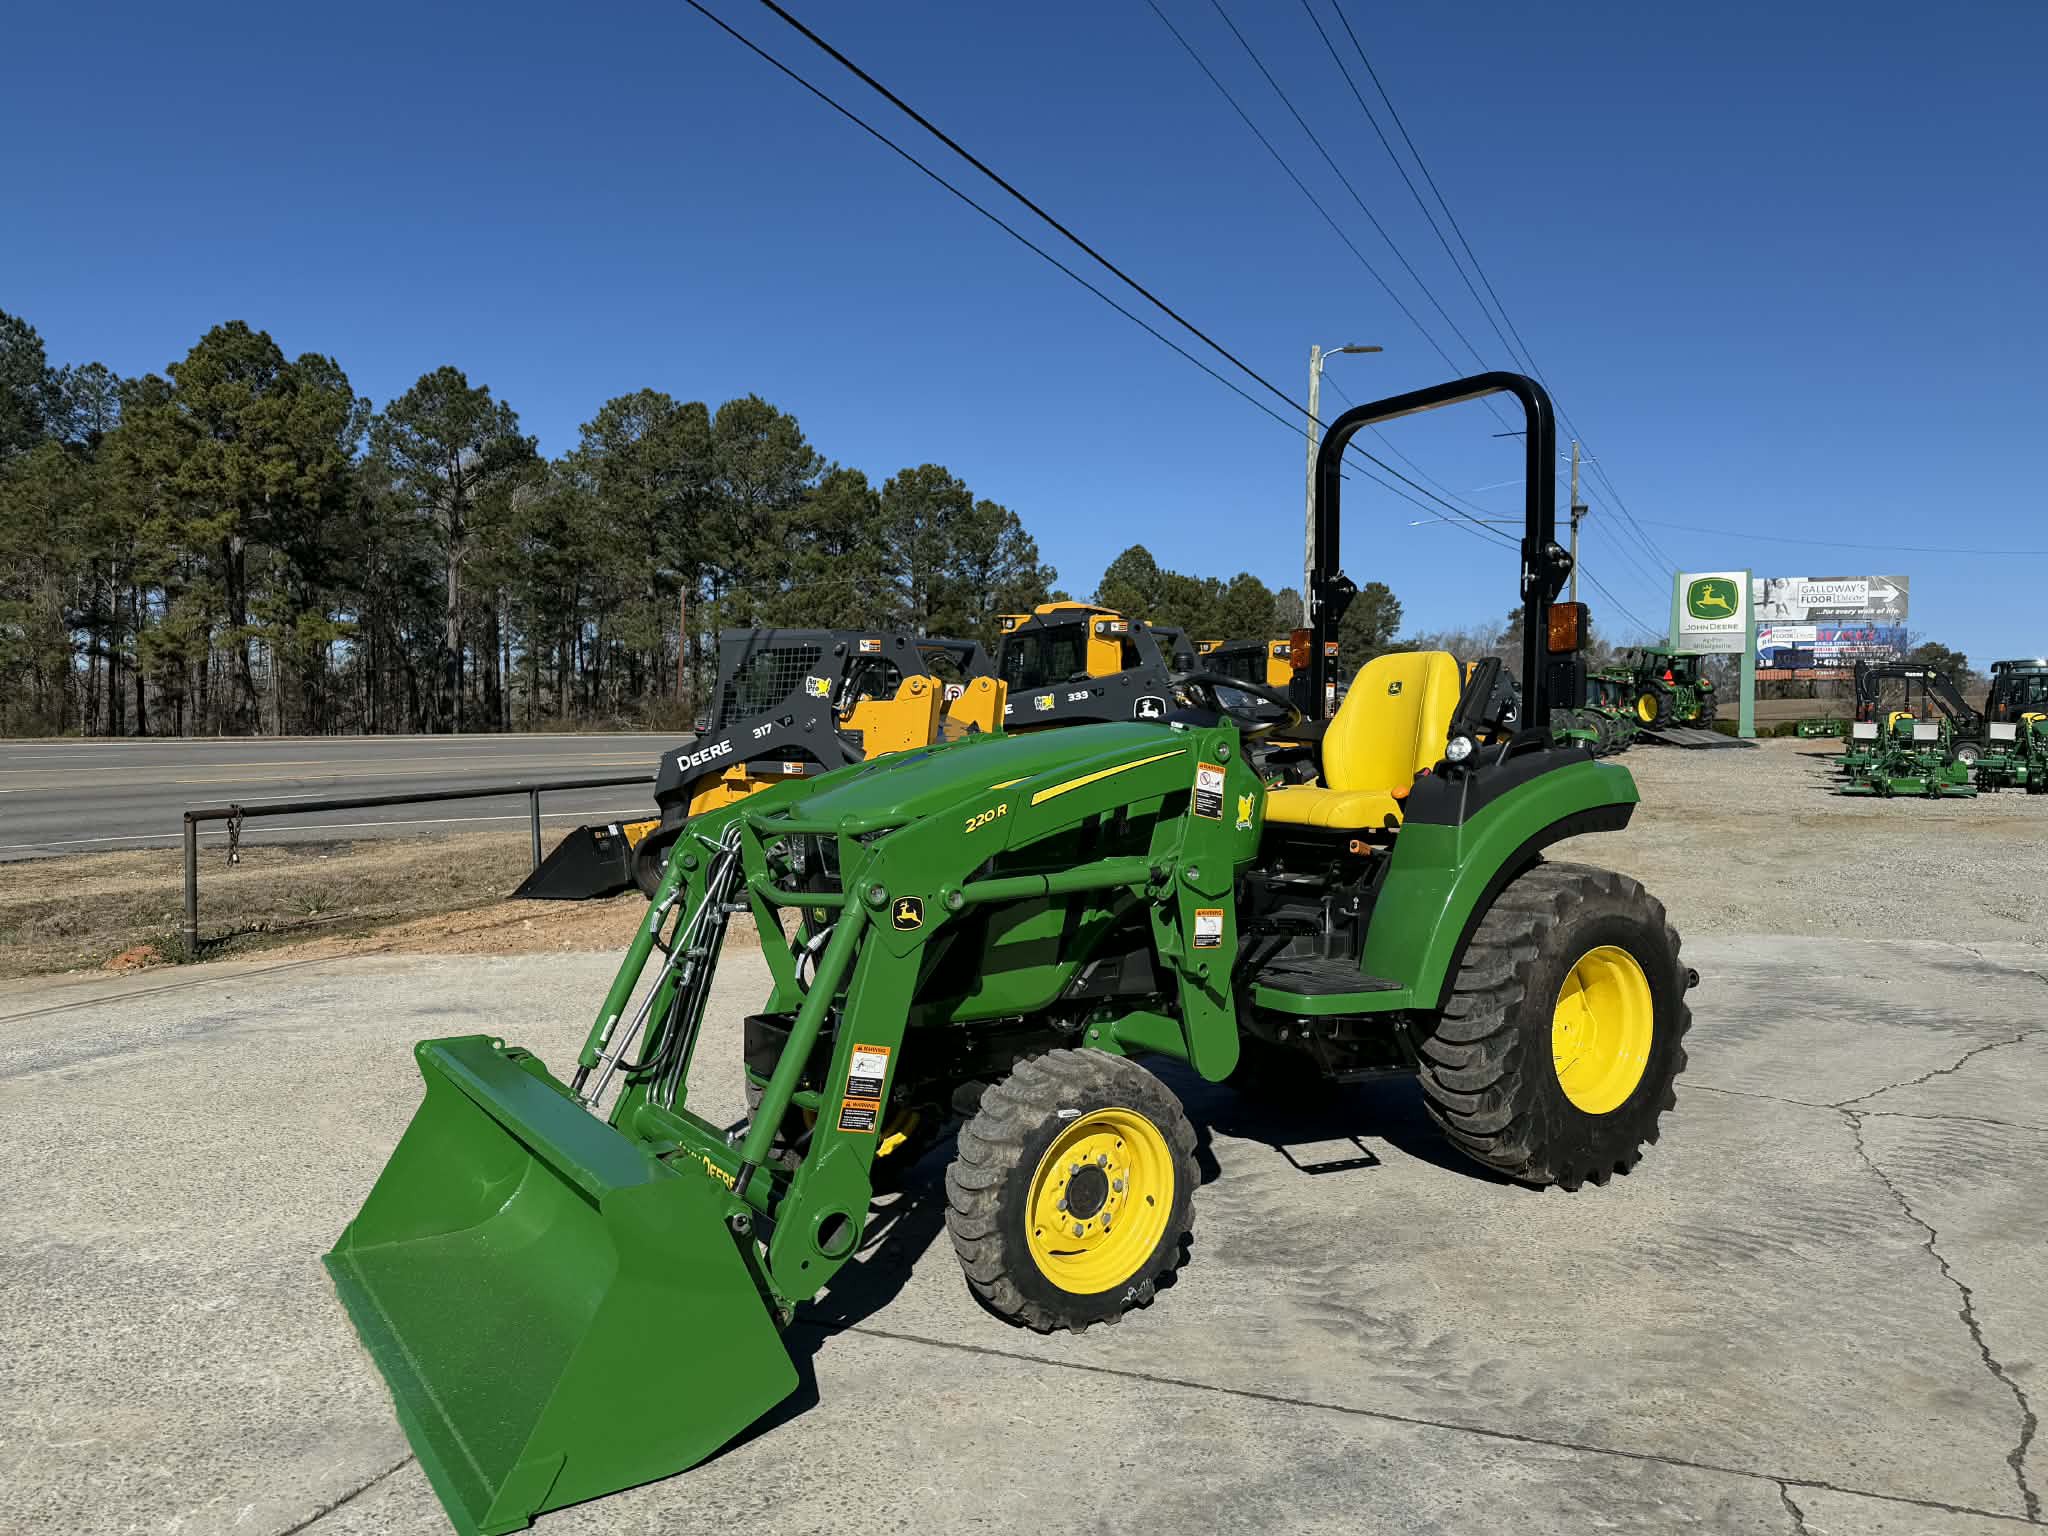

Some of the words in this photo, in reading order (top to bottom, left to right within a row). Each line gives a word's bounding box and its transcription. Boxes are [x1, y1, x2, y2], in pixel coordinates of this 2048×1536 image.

[1801, 583, 1866, 594] GALLOWAY'S
[1801, 595, 1832, 604] FLOOR
[1684, 623, 1709, 631] JOHN
[1067, 690, 1089, 702] 333
[753, 723, 772, 739] 317
[676, 739, 733, 772] DEERE
[863, 1046, 886, 1054] WARNING
[852, 1102, 876, 1110] WARNING
